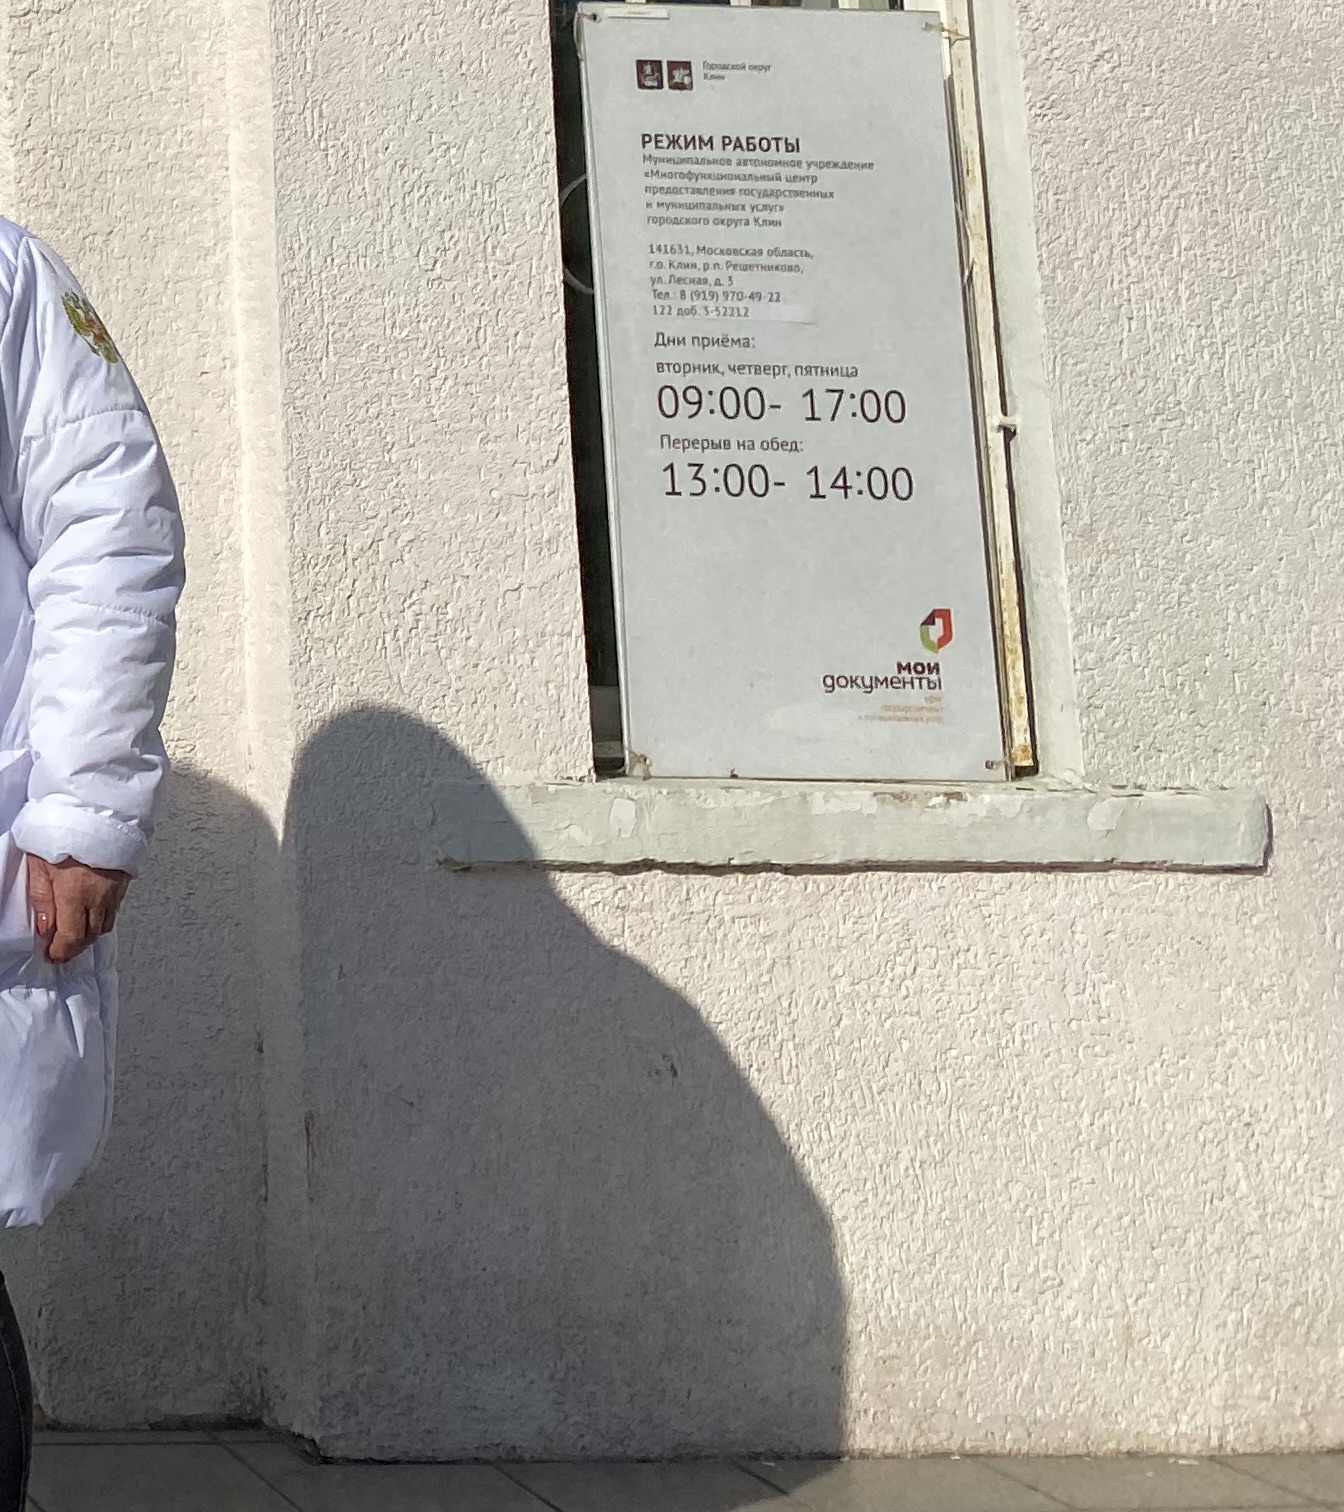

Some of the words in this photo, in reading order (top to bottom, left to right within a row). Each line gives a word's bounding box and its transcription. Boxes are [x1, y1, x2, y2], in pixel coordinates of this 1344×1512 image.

[641, 133, 714, 151] РЕЖИМ
[722, 136, 800, 153] РАБОТЫ
[805, 160, 875, 171] учреждение
[785, 173, 818, 185] центр
[647, 217, 710, 227] городского
[713, 218, 751, 228] округа
[753, 218, 782, 228] Клин
[696, 245, 763, 257] Московская
[654, 333, 687, 348] Дни
[691, 333, 756, 351] приёма:
[656, 362, 724, 377] вторник,
[728, 364, 791, 379] четверг,
[794, 364, 859, 379] пятница
[657, 385, 782, 420] 09:00-
[802, 388, 907, 423] 17:00
[660, 434, 732, 452] Перерыв
[737, 439, 756, 451] на
[760, 438, 804, 453] обед:
[662, 461, 786, 497] 13:00-
[806, 465, 914, 501] 14:00
[822, 674, 942, 694] документы
